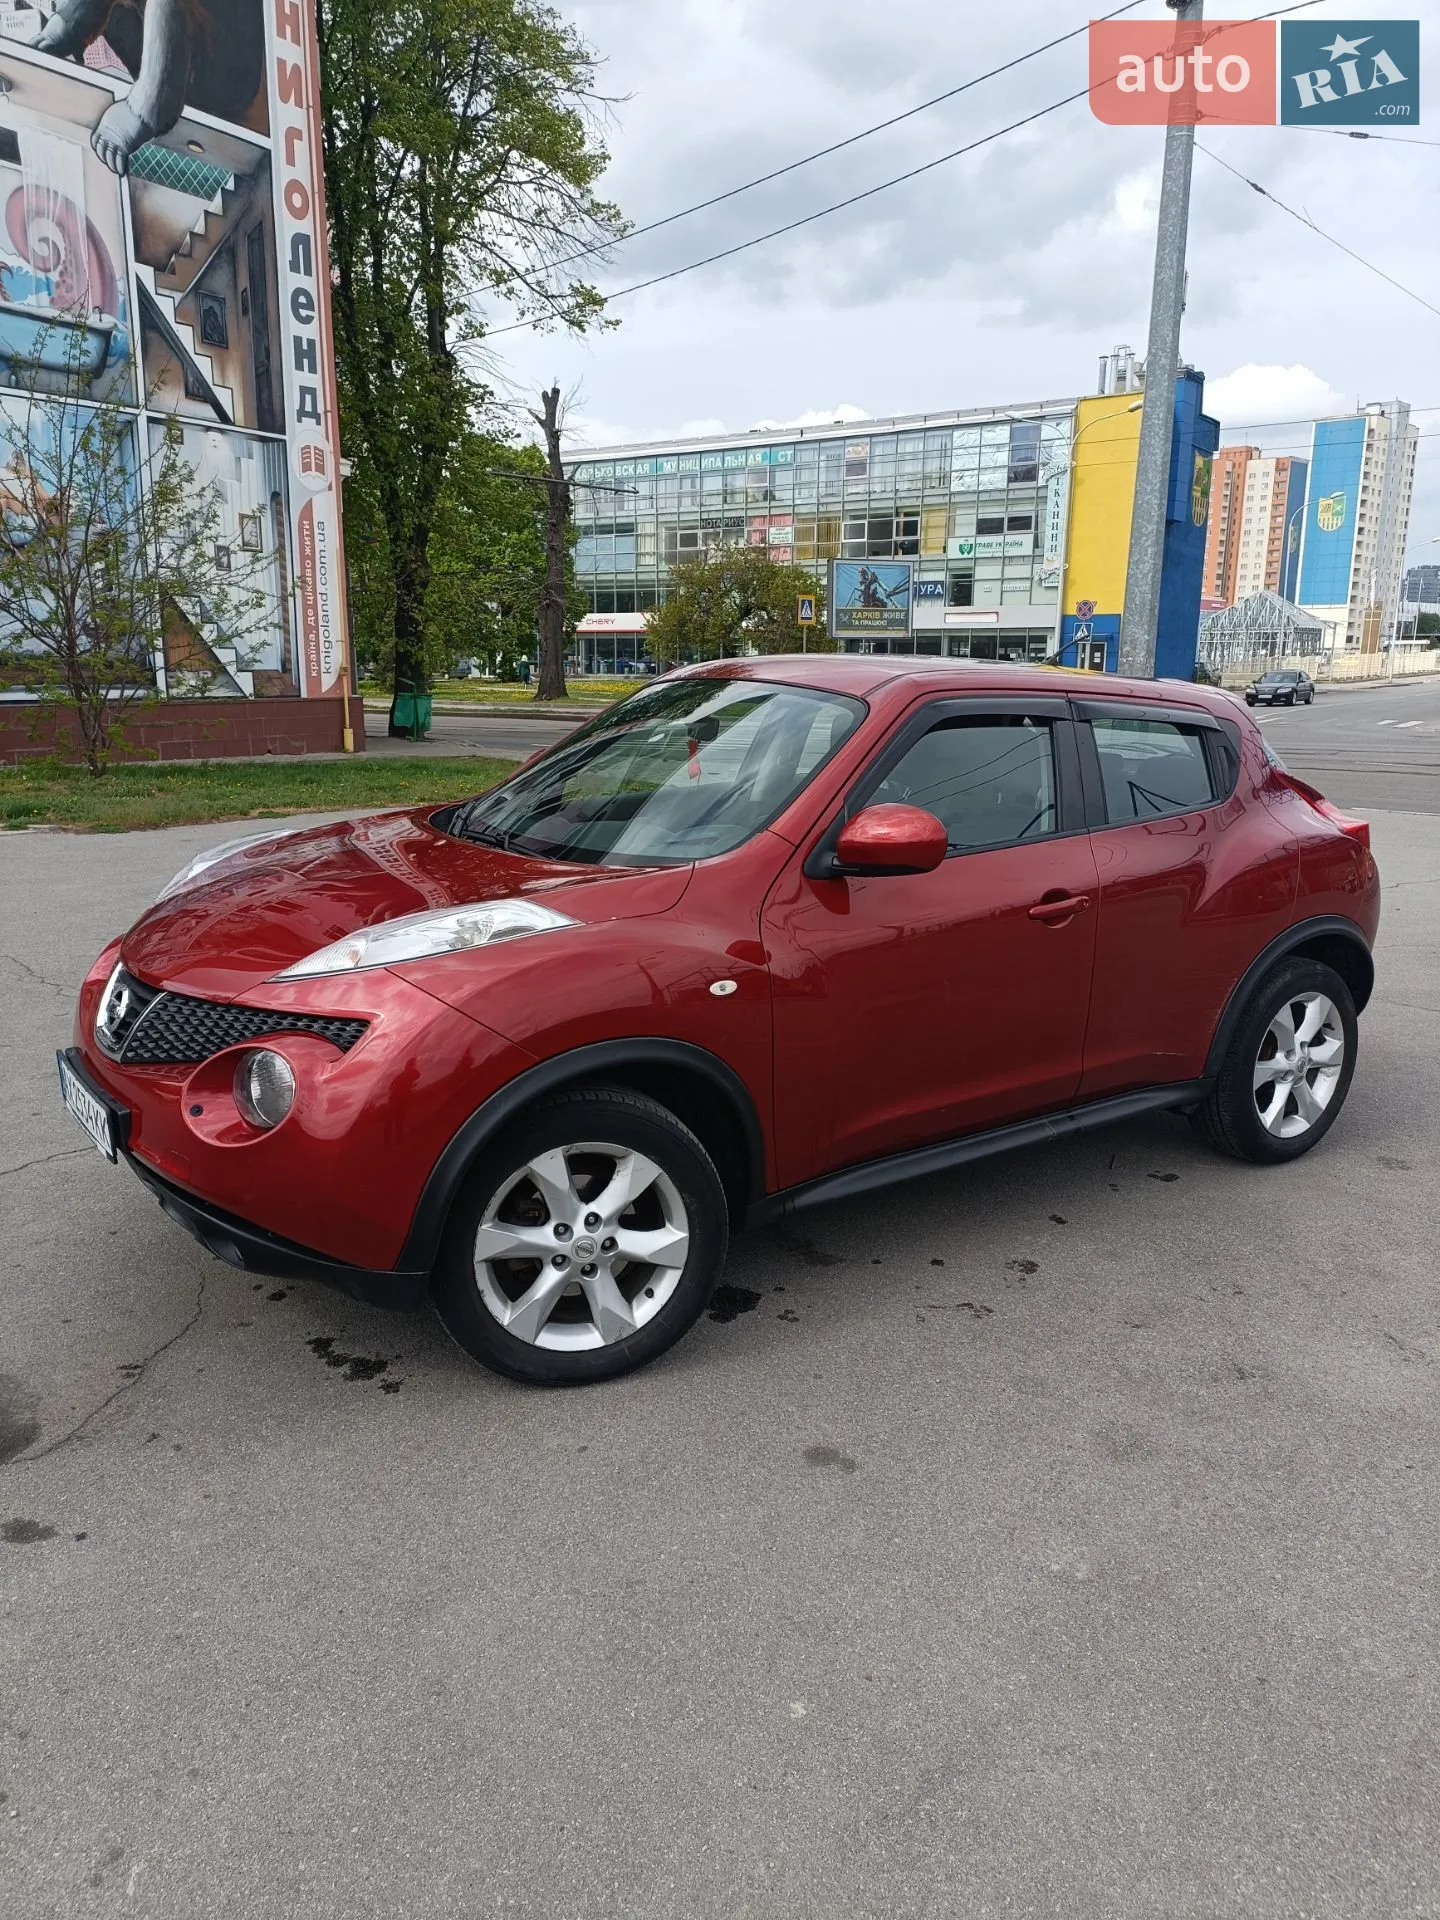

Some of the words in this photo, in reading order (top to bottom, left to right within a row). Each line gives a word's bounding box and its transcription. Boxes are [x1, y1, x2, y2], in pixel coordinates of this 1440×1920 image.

[663, 454, 761, 472] МУНИЦИПАЛЬНАЯ
[777, 451, 793, 462] СТ
[700, 517, 745, 528] НОТАРИУС
[302, 520, 311, 556] жити
[304, 560, 314, 604] цікаво
[914, 584, 943, 595] УРА
[317, 520, 333, 675] knigoland.com.ua
[307, 608, 316, 627] де
[851, 611, 881, 619] ХАРКІВ
[882, 611, 906, 619] ЖИВЕ
